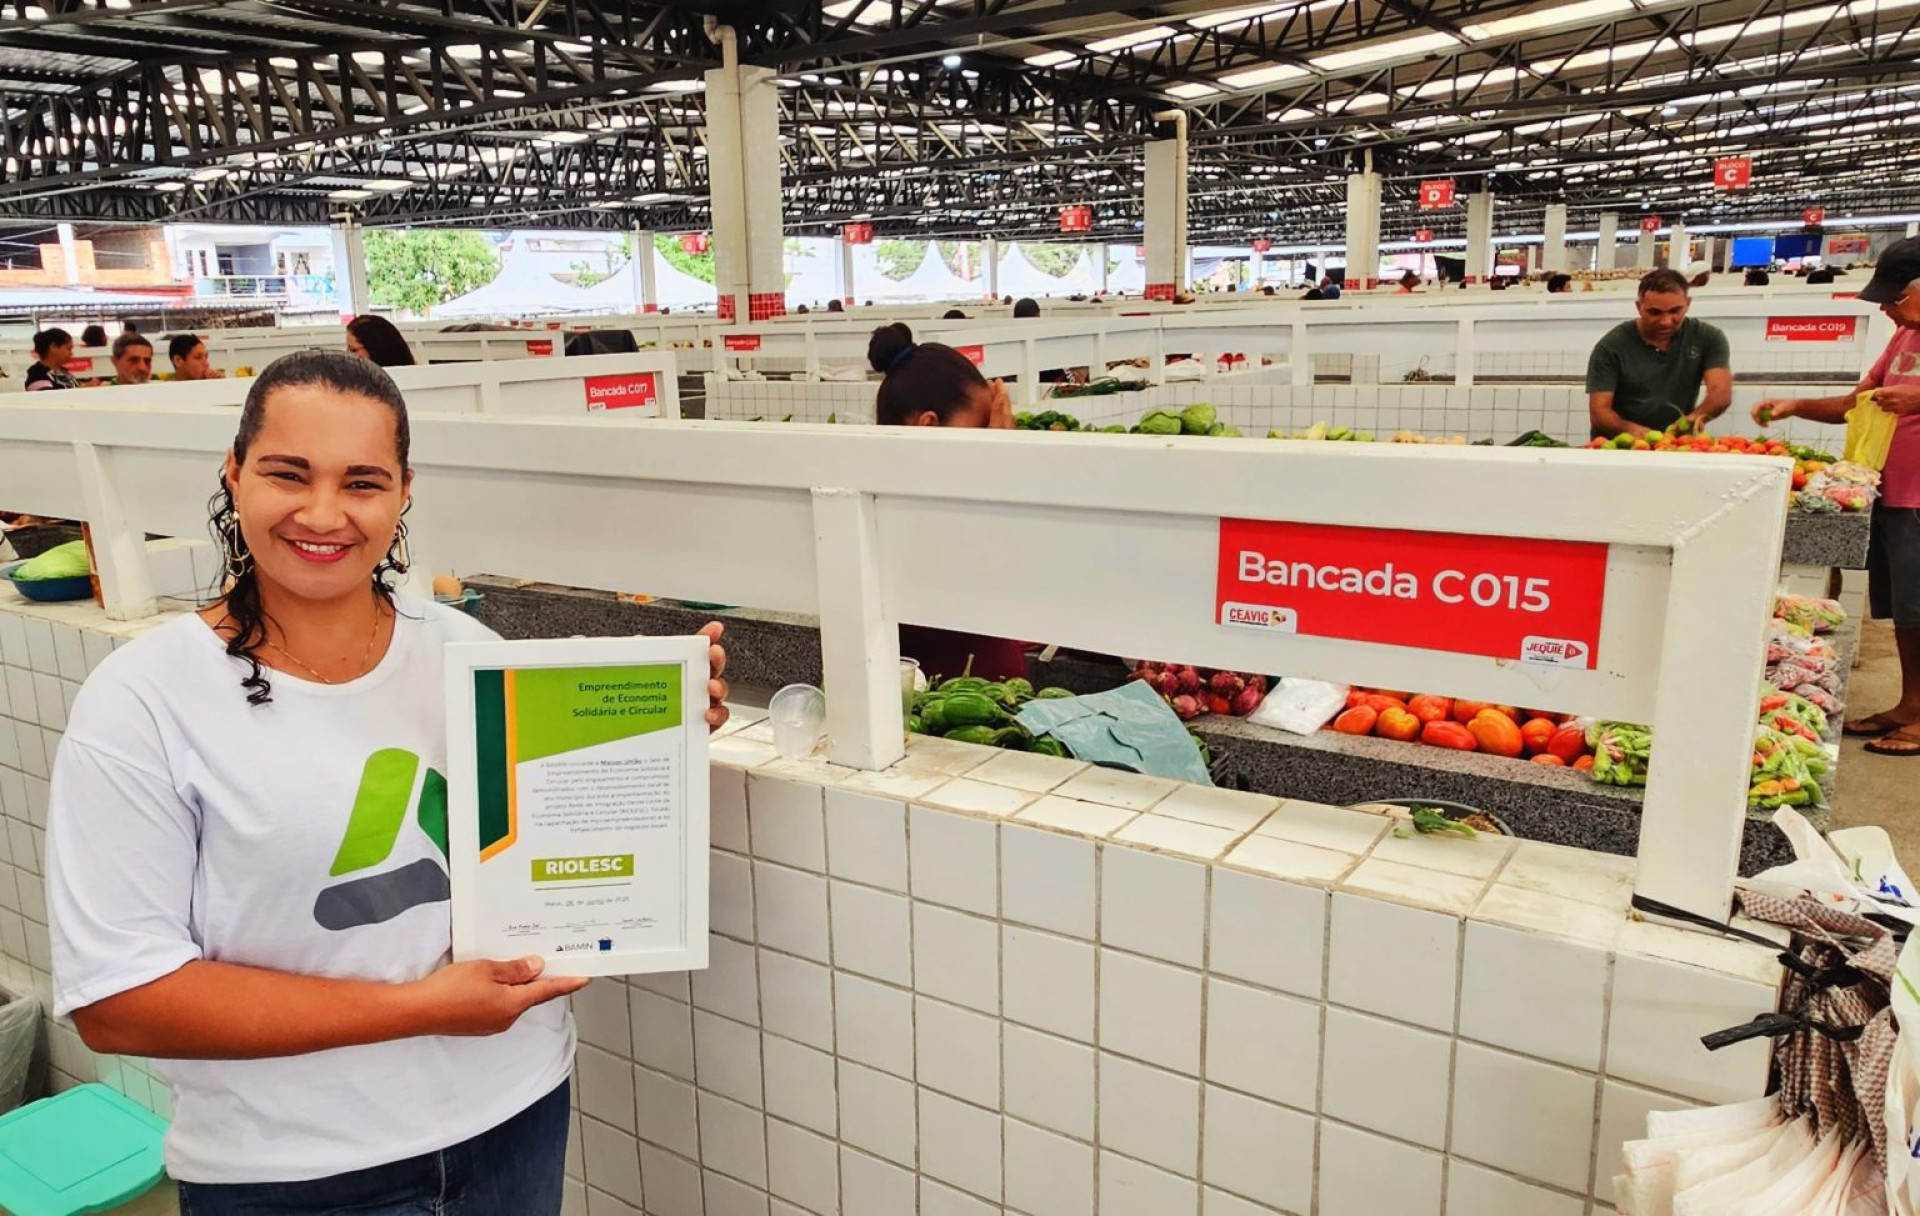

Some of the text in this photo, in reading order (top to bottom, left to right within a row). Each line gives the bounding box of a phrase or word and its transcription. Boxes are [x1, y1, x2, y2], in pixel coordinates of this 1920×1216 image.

[1724, 169, 1738, 181] C
[1428, 190, 1441, 202] D
[1772, 323, 1846, 332] Bancada C019
[589, 383, 648, 398] Bancada C017
[1238, 550, 1551, 613] Bancada C015
[1229, 608, 1269, 623] CEAVIG
[579, 681, 667, 692] Empreendimento
[602, 693, 667, 703] de Economia
[572, 705, 668, 717] Solidária e Circular
[545, 857, 623, 875] RIOLESC
